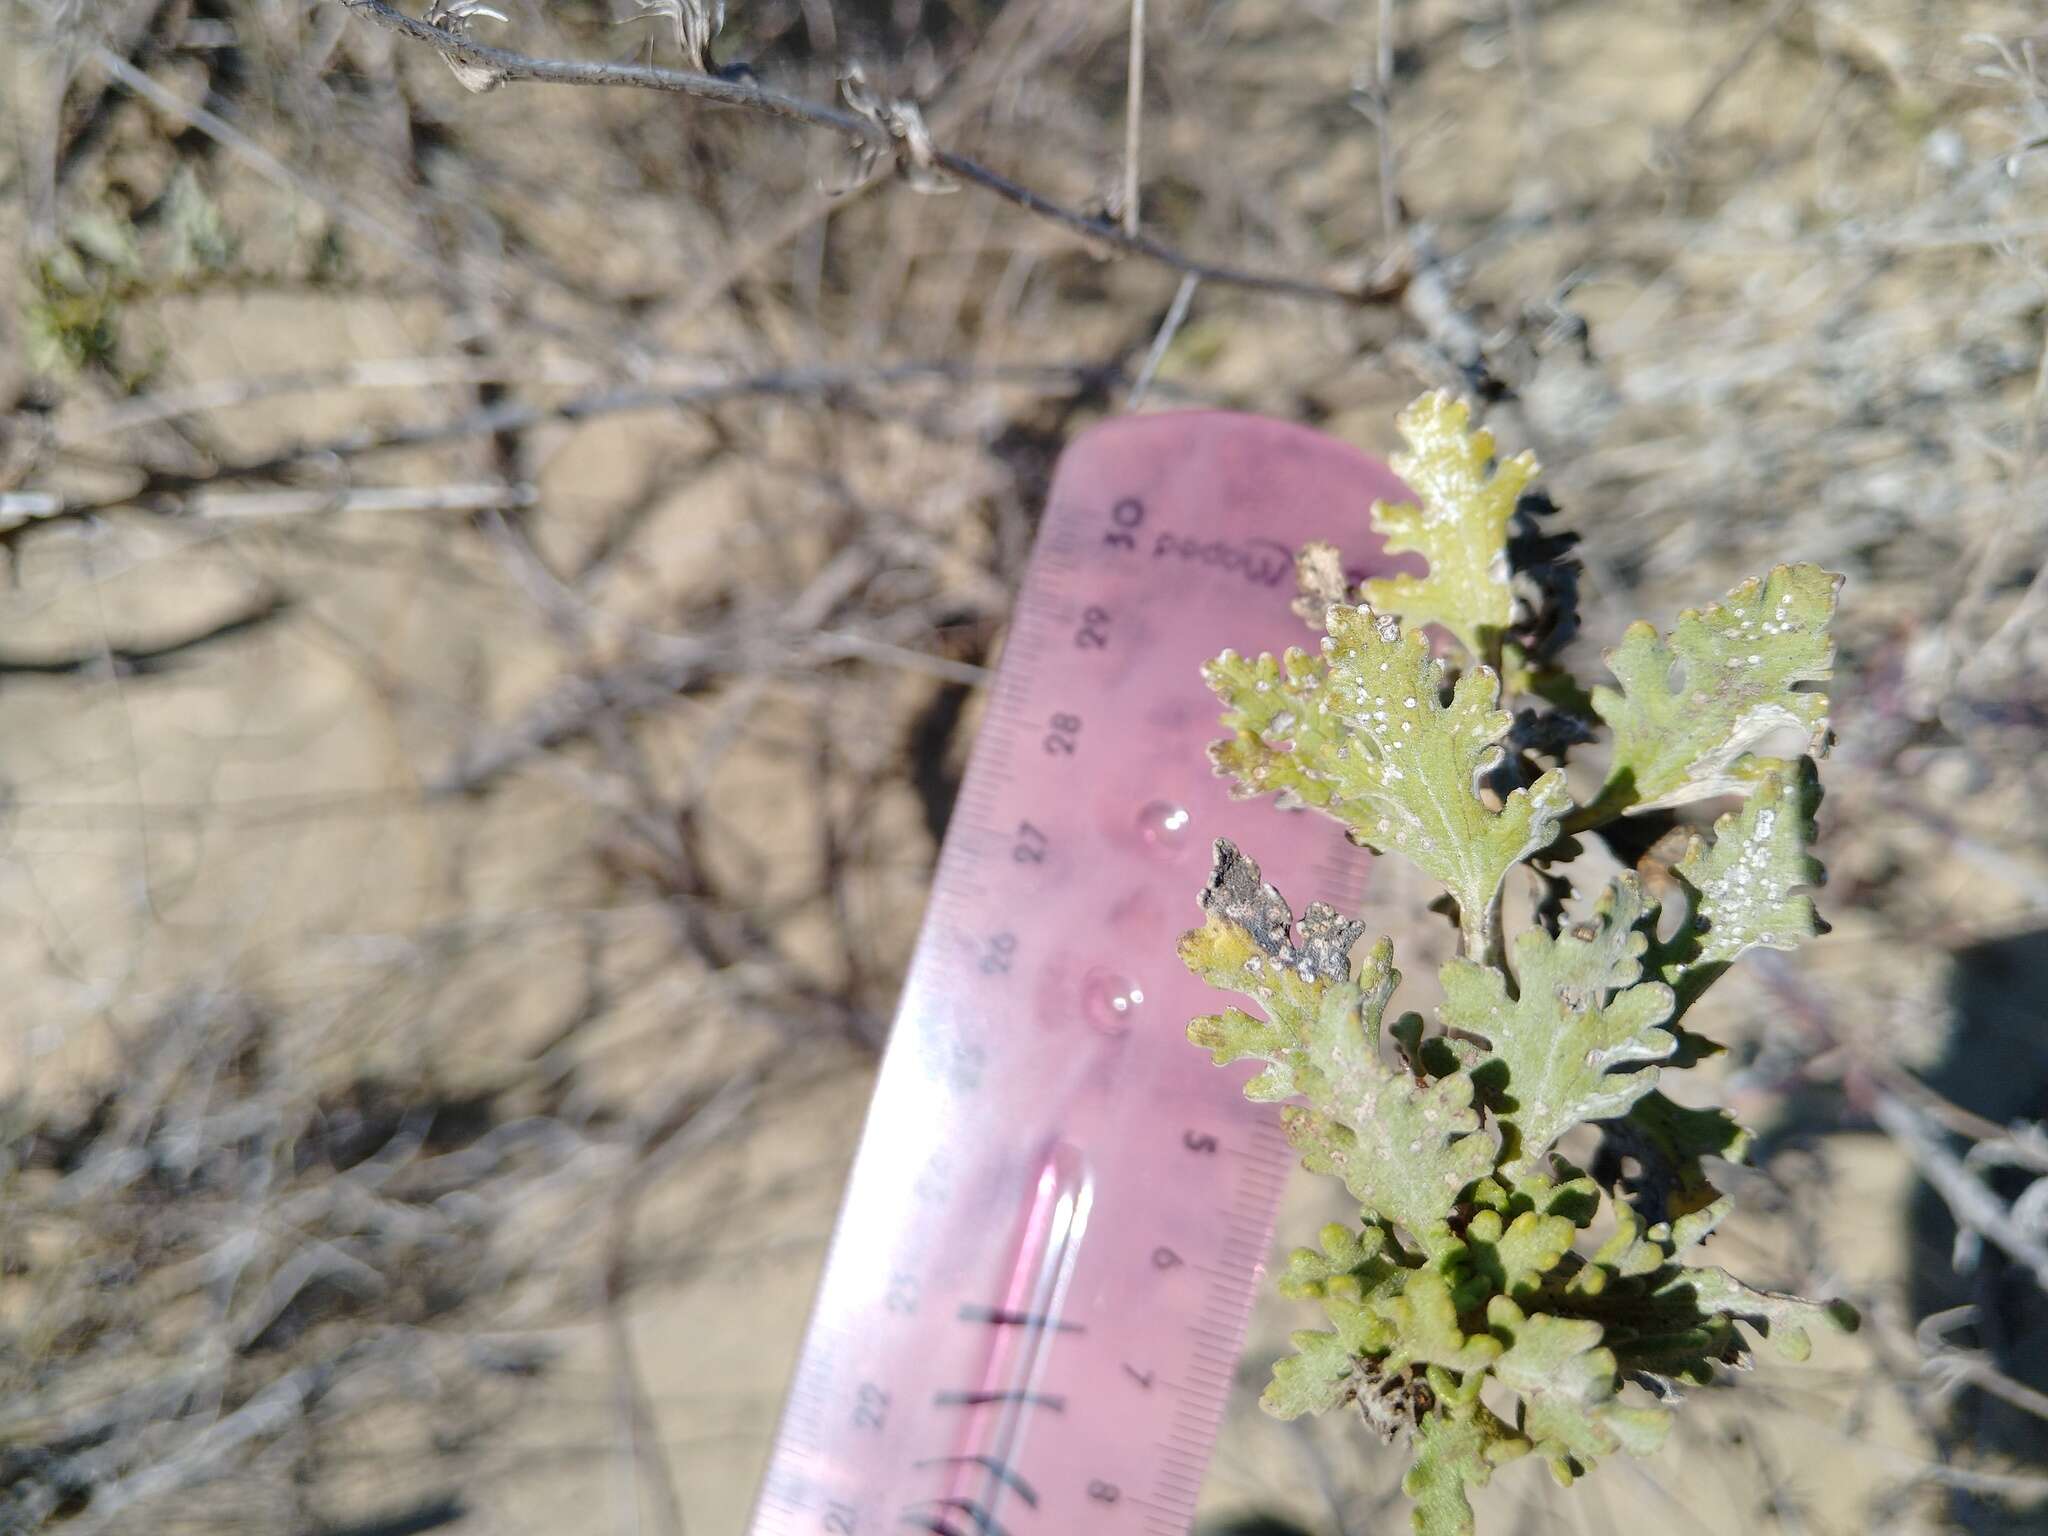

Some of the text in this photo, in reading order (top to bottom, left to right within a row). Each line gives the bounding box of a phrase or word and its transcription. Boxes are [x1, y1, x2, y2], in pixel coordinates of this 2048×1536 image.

[1103, 498, 1145, 550] 30
[1075, 604, 1110, 648] 29
[1043, 712, 1083, 756] 28
[1012, 820, 1049, 864] 27
[1182, 1128, 1218, 1154] 5
[1152, 1246, 1184, 1271] 6
[1120, 1362, 1154, 1387] 7
[1086, 1478, 1121, 1504] 8
